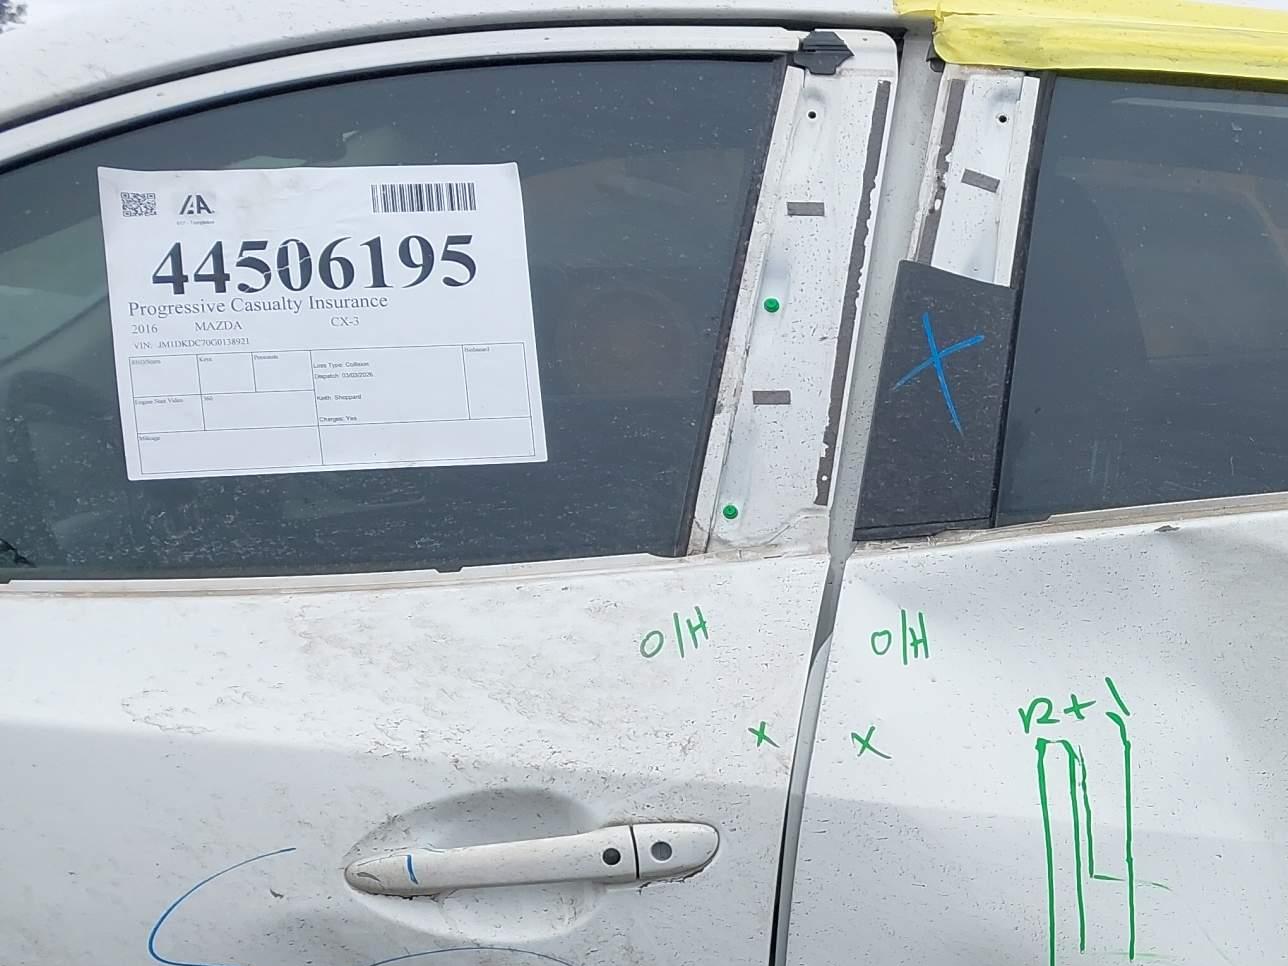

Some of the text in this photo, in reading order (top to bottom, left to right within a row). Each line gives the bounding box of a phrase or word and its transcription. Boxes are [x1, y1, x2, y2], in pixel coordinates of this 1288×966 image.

[152, 234, 477, 295] 44506195
[128, 295, 389, 319] Progressive Casualty Insurance
[131, 316, 361, 334] 2016 MAZDA CX-3
